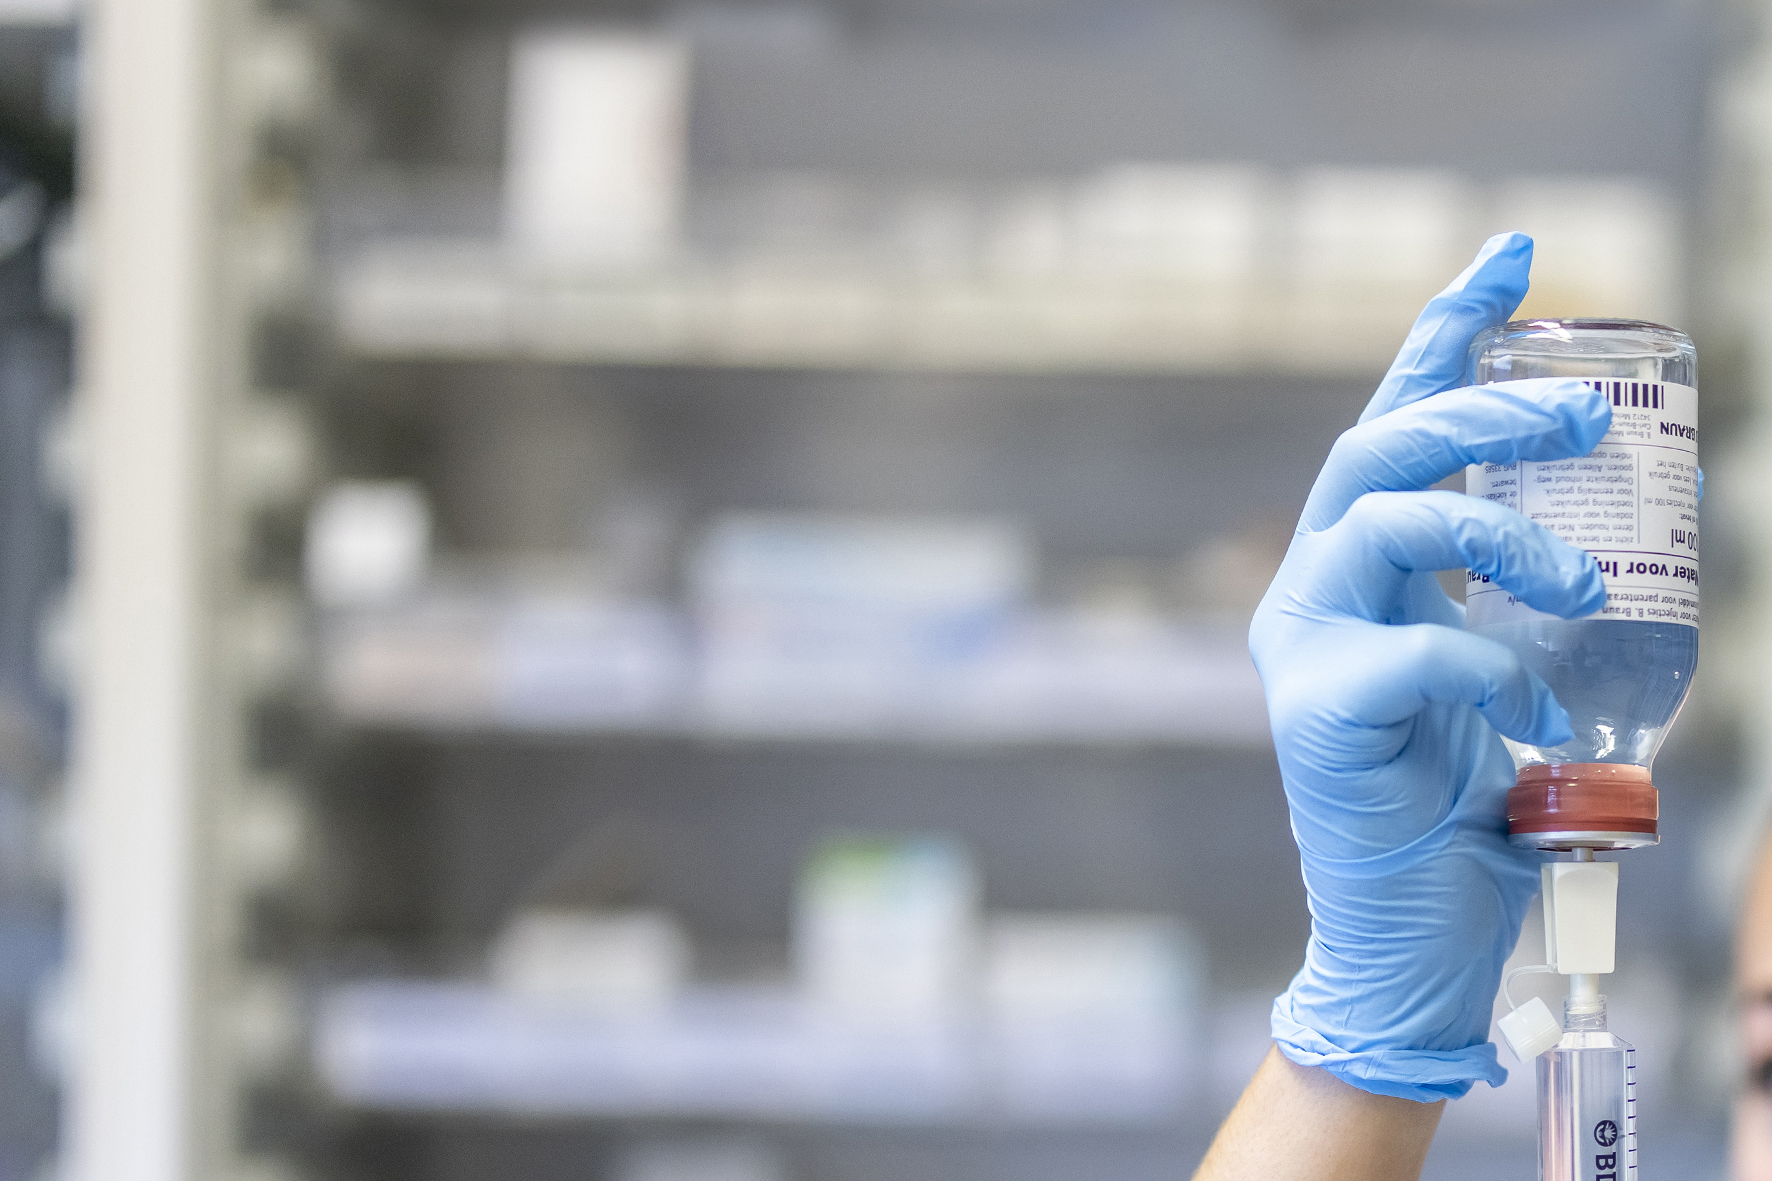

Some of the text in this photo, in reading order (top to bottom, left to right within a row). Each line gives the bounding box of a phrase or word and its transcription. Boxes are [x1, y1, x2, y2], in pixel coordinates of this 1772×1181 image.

[1661, 422, 1695, 441] BRAUN
[1578, 464, 1603, 472] Alleen
[1617, 489, 1633, 497] Voor
[1672, 529, 1685, 548] ml
[1626, 562, 1668, 576] voor
[1606, 593, 1658, 603] parenteraa
[1662, 596, 1676, 604] voor
[1602, 607, 1631, 617] Braun
[1635, 608, 1644, 618] B.
[1648, 608, 1678, 620] Injecties
